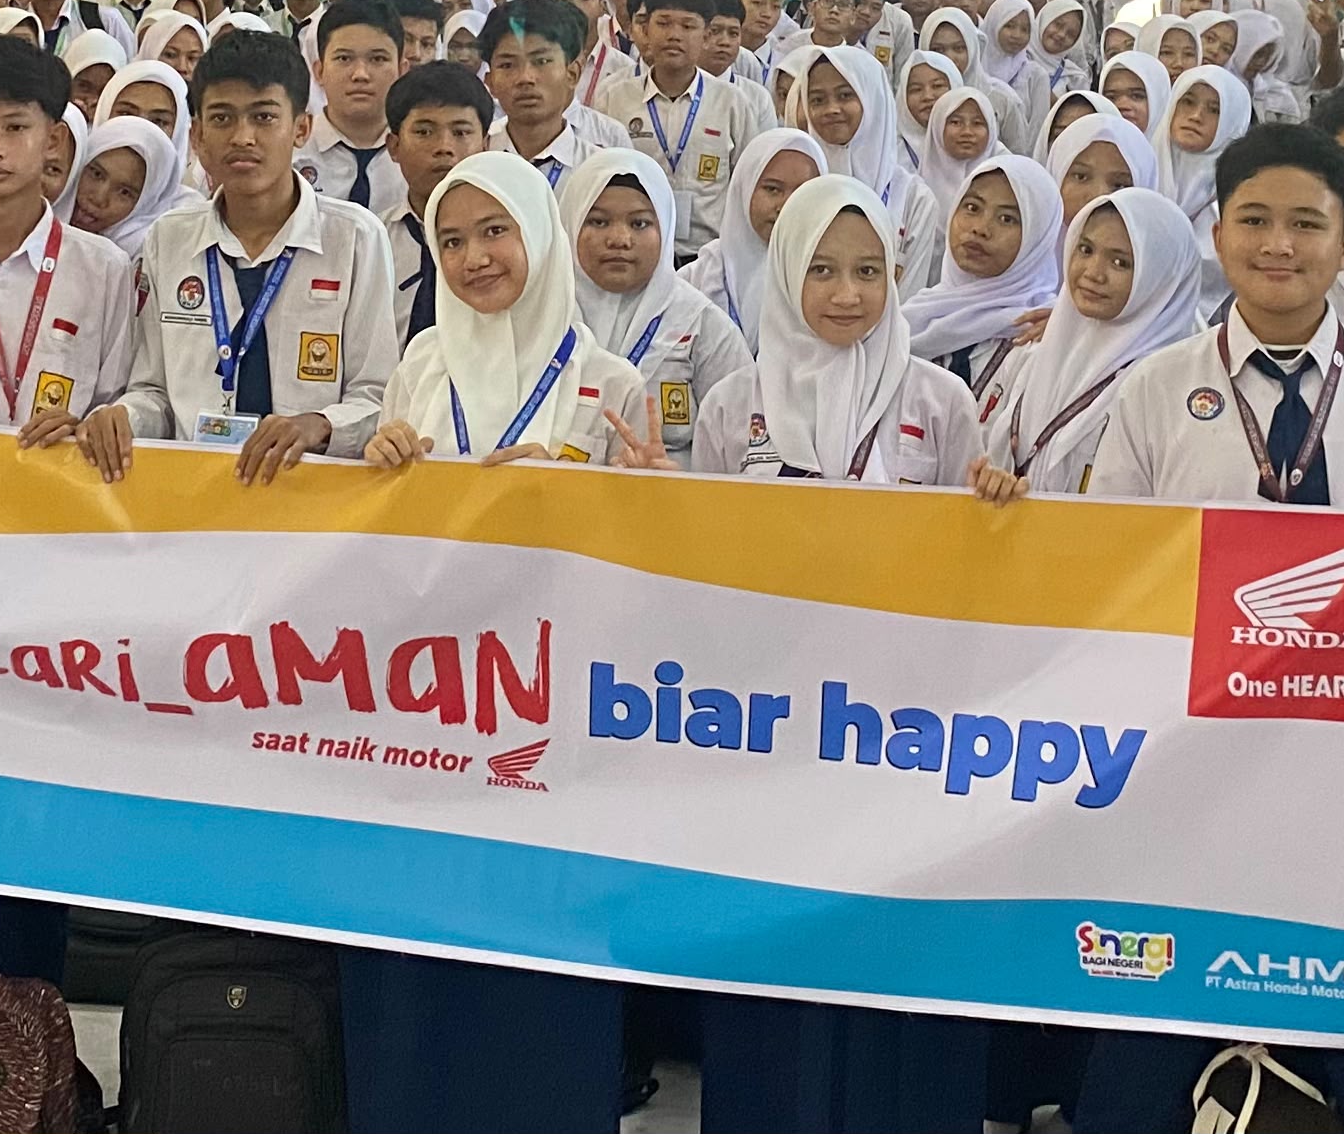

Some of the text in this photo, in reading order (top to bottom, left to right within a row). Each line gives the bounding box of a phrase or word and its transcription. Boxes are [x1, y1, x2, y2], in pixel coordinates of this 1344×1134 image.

[1227, 670, 1277, 700] One
[588, 661, 790, 754] biar
[819, 681, 1148, 809] happy
[252, 729, 473, 773] saat naik motor
[486, 776, 550, 792] HONDA
[1082, 955, 1143, 969] BAGI NEGERI
[1205, 976, 1220, 989] PT
[1224, 977, 1261, 992] Astra
[1264, 980, 1308, 996] Honda
